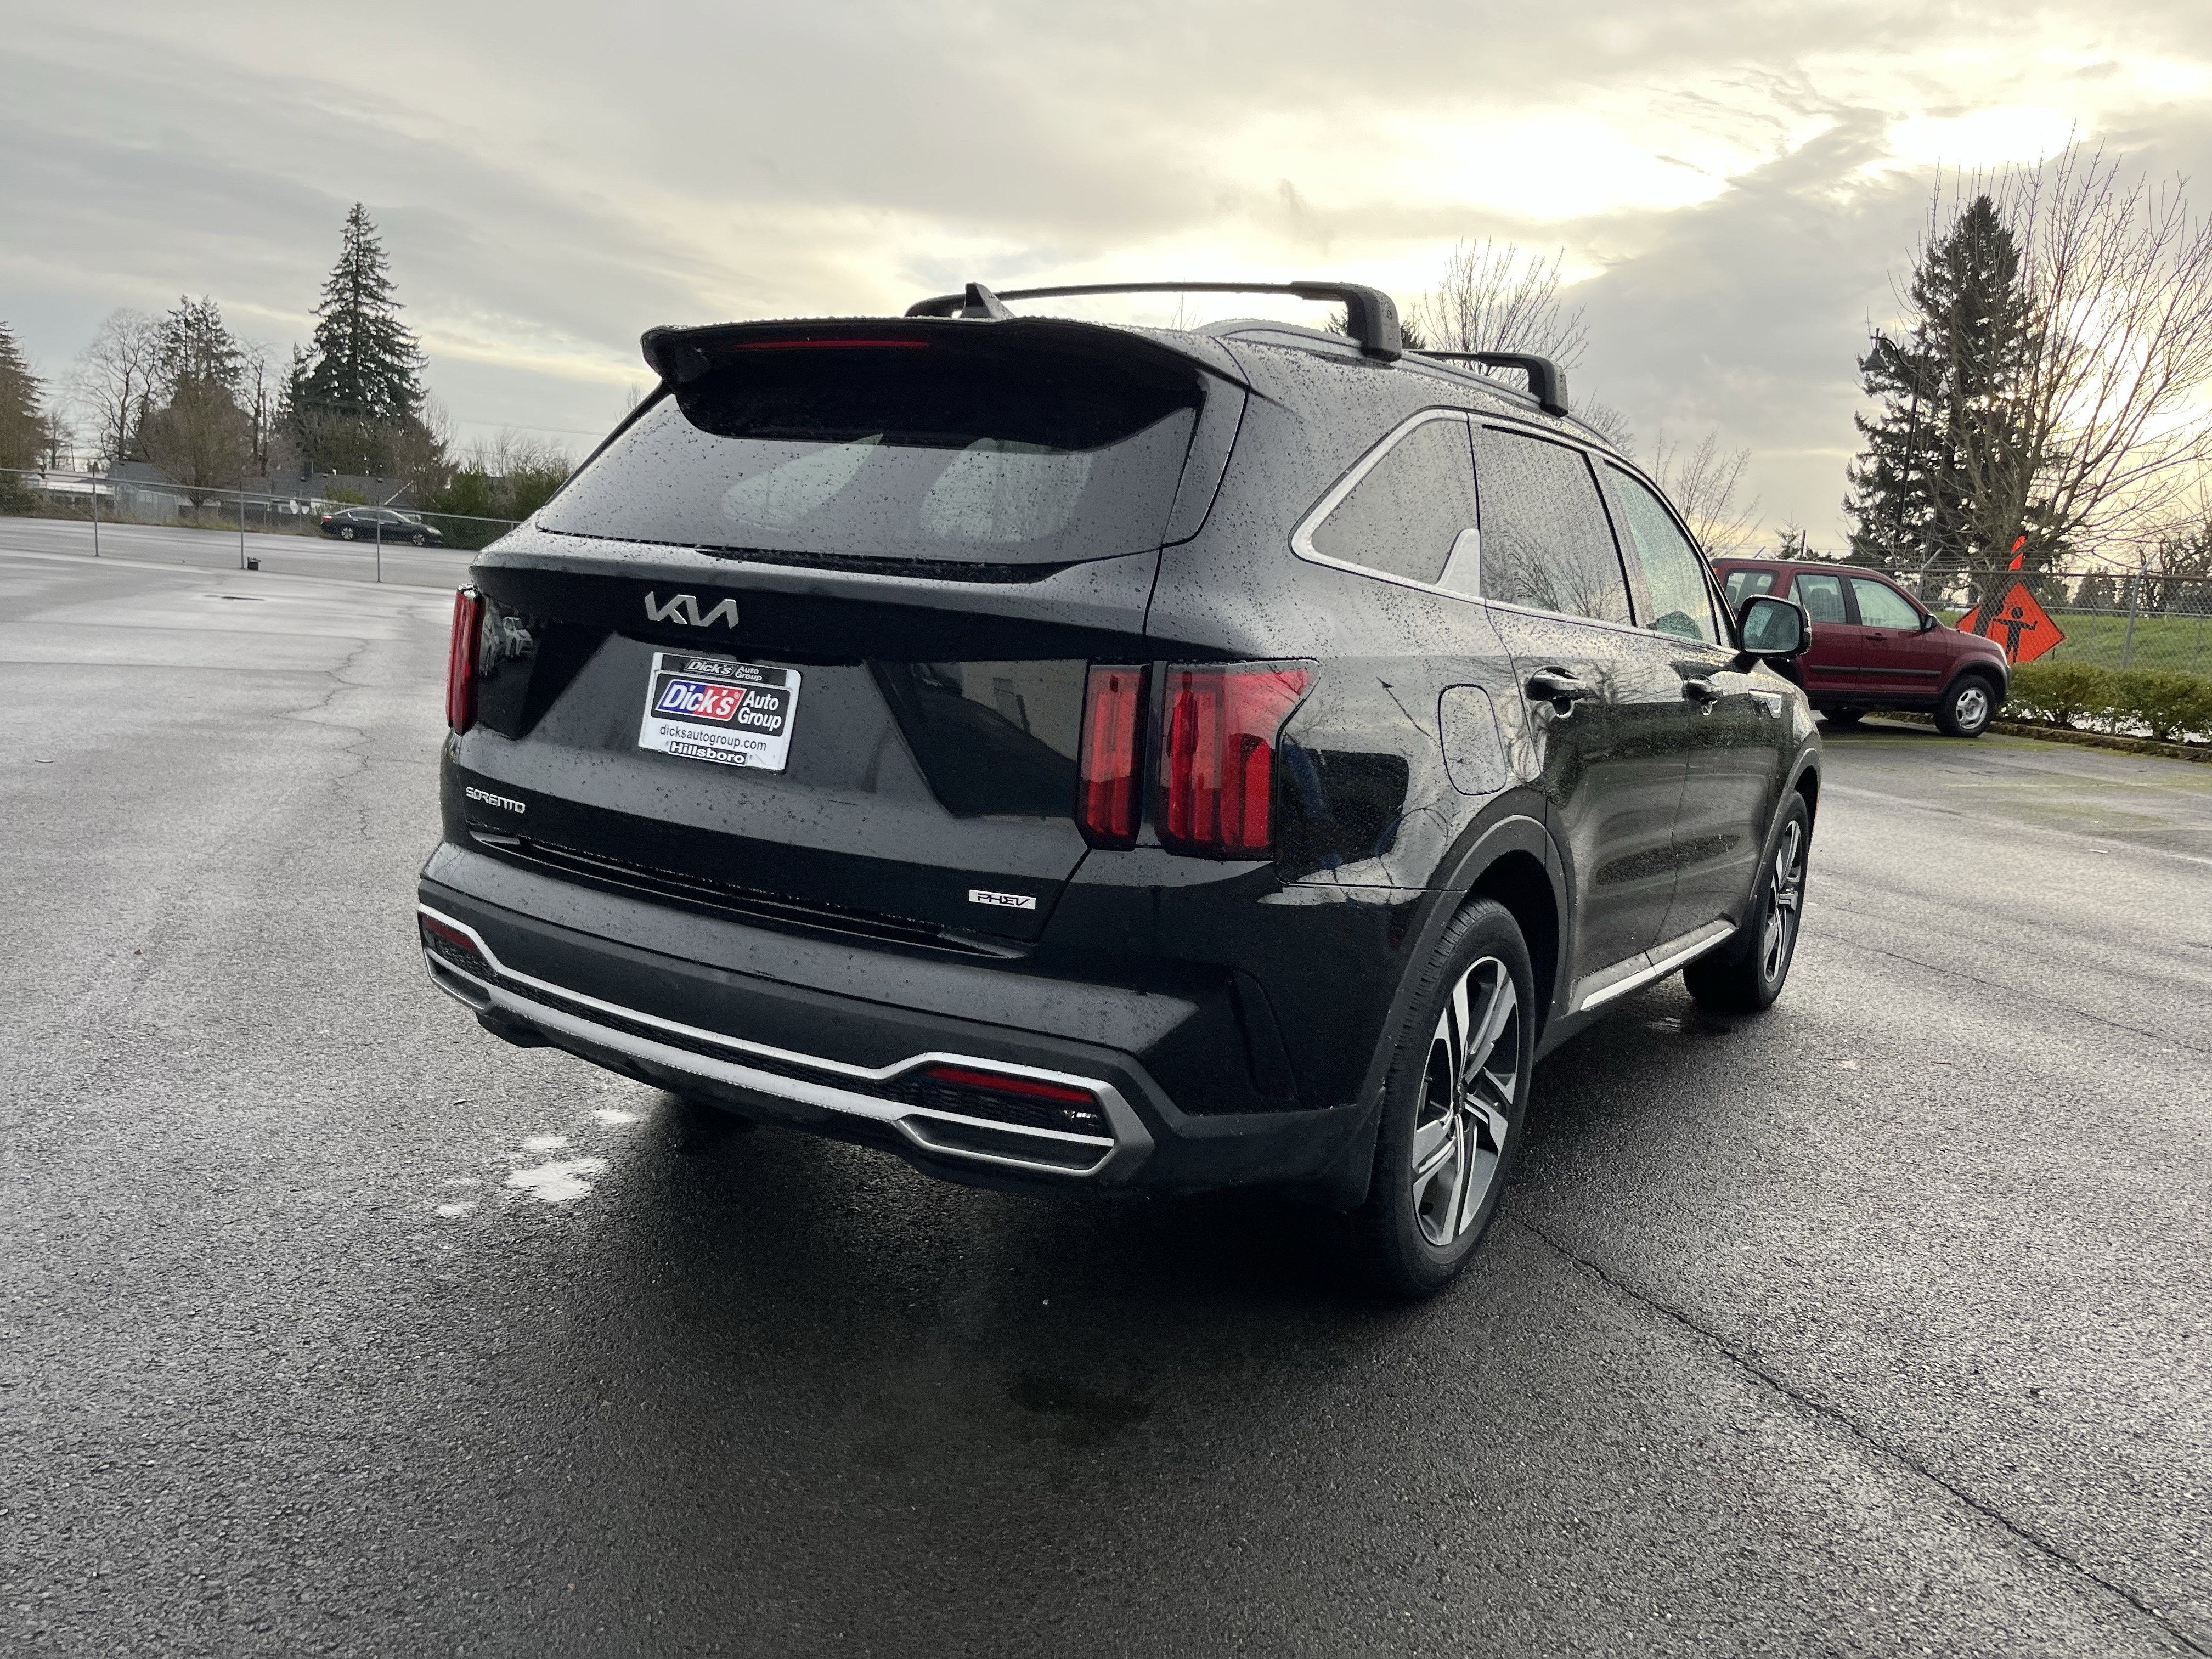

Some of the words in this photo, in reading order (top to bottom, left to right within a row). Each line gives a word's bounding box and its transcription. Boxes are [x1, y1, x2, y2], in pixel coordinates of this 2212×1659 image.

[687, 660, 733, 674] Dick's
[734, 671, 763, 682] Group
[738, 665, 760, 674] Auto
[662, 684, 734, 716] Dick's
[742, 690, 780, 711] Auto
[737, 707, 782, 732] Group
[659, 724, 766, 752] dicksautogroup.com
[669, 742, 746, 764] Hillsboro
[466, 786, 526, 814] SORENTO
[978, 893, 1030, 906] PHEV
